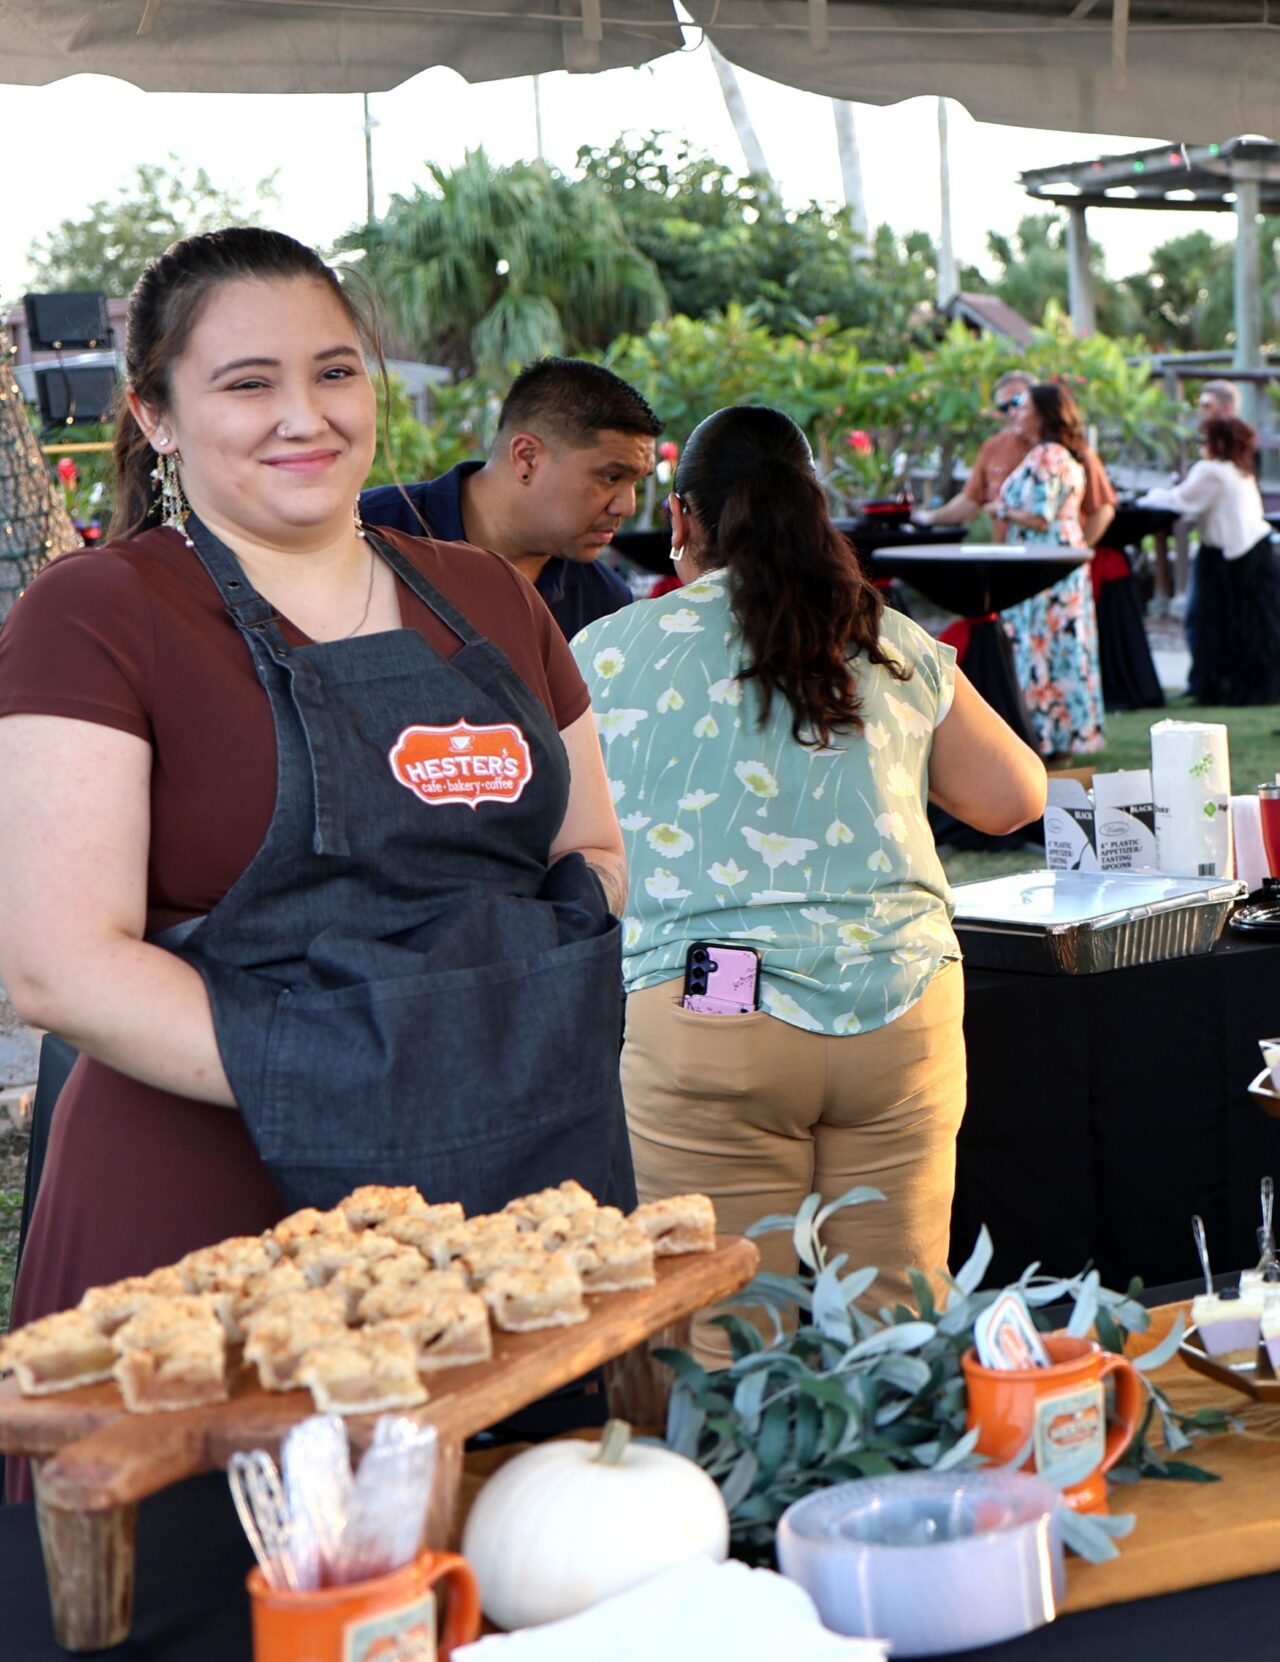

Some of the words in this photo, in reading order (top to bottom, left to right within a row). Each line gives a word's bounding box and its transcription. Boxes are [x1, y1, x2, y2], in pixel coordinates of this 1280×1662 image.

[405, 748, 520, 783] HESTER'S
[485, 776, 513, 790] coffee
[1130, 805, 1152, 813] BLACK
[1074, 811, 1093, 819] BLACK
[1110, 839, 1140, 847] PLASTIC
